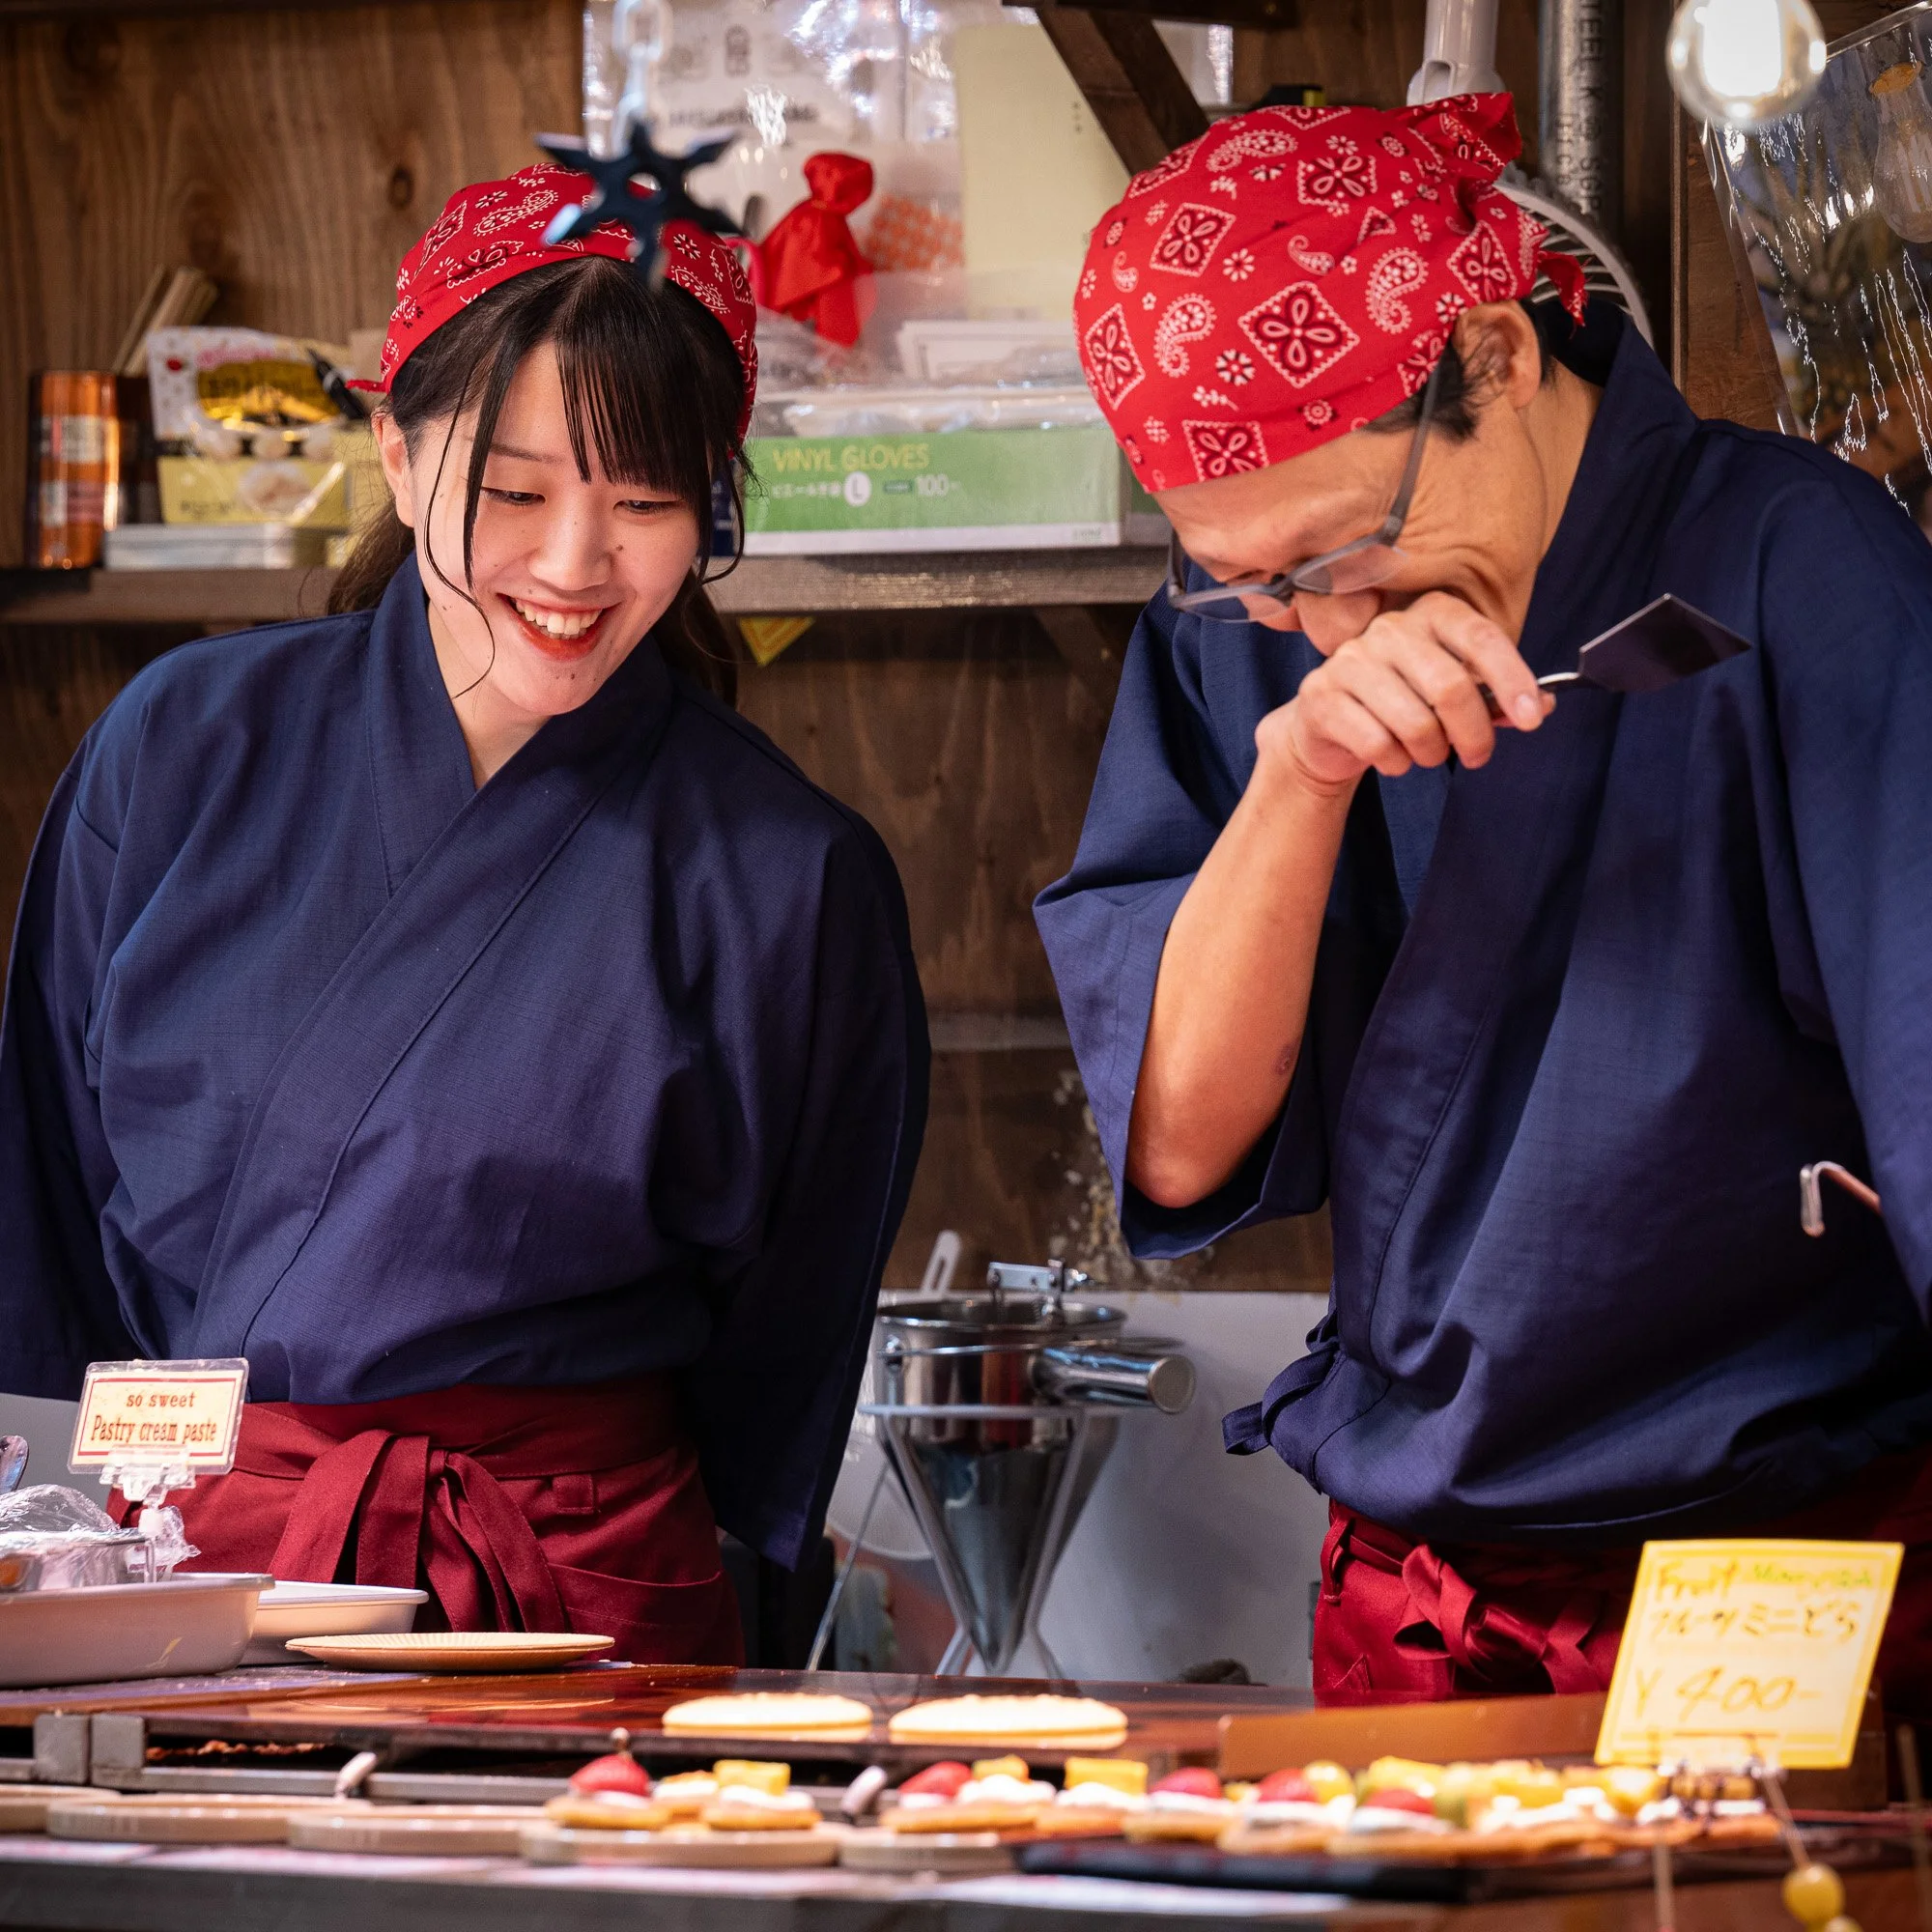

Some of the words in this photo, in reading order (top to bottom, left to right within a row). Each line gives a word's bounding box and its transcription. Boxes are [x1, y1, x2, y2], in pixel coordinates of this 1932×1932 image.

[773, 445, 835, 472] VINYL
[840, 442, 930, 471] GLOVES
[126, 1393, 143, 1408] so
[148, 1391, 197, 1408] sweet
[91, 1414, 135, 1444] Pastry
[139, 1421, 178, 1442] cream
[182, 1418, 217, 1445] paste
